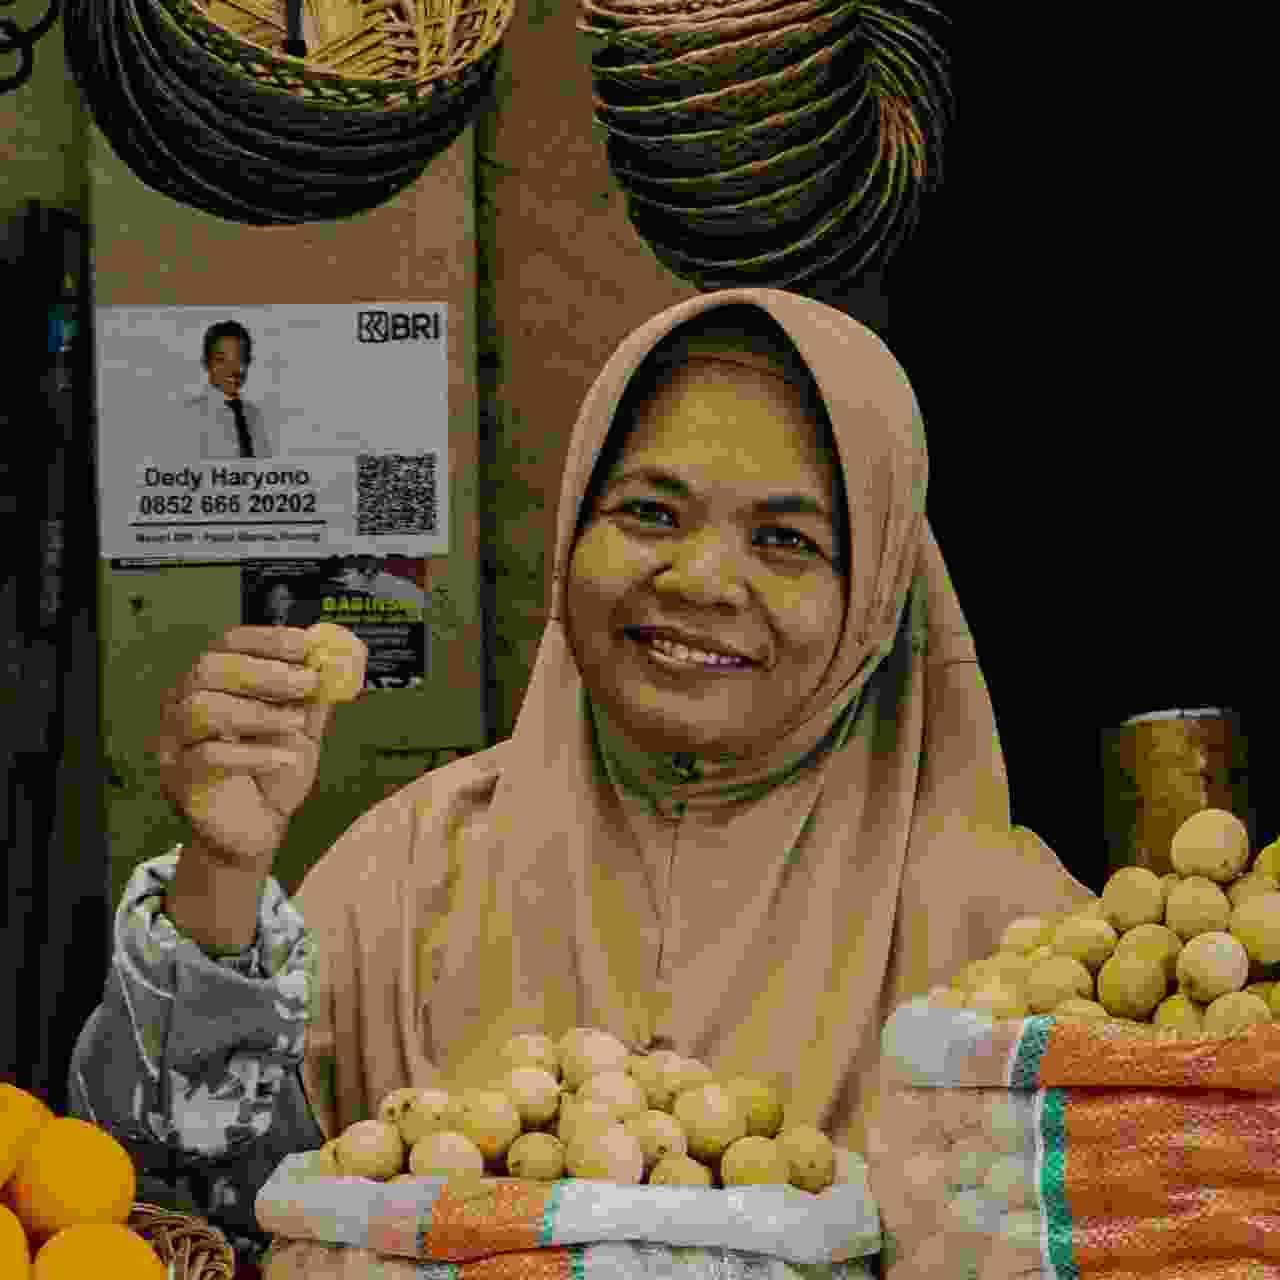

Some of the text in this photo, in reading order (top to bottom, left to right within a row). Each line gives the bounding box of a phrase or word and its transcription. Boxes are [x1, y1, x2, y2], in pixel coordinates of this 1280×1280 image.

[392, 312, 440, 340] BRI
[145, 467, 310, 491] Dedy Haryono
[139, 493, 316, 514] 0852 666 20202
